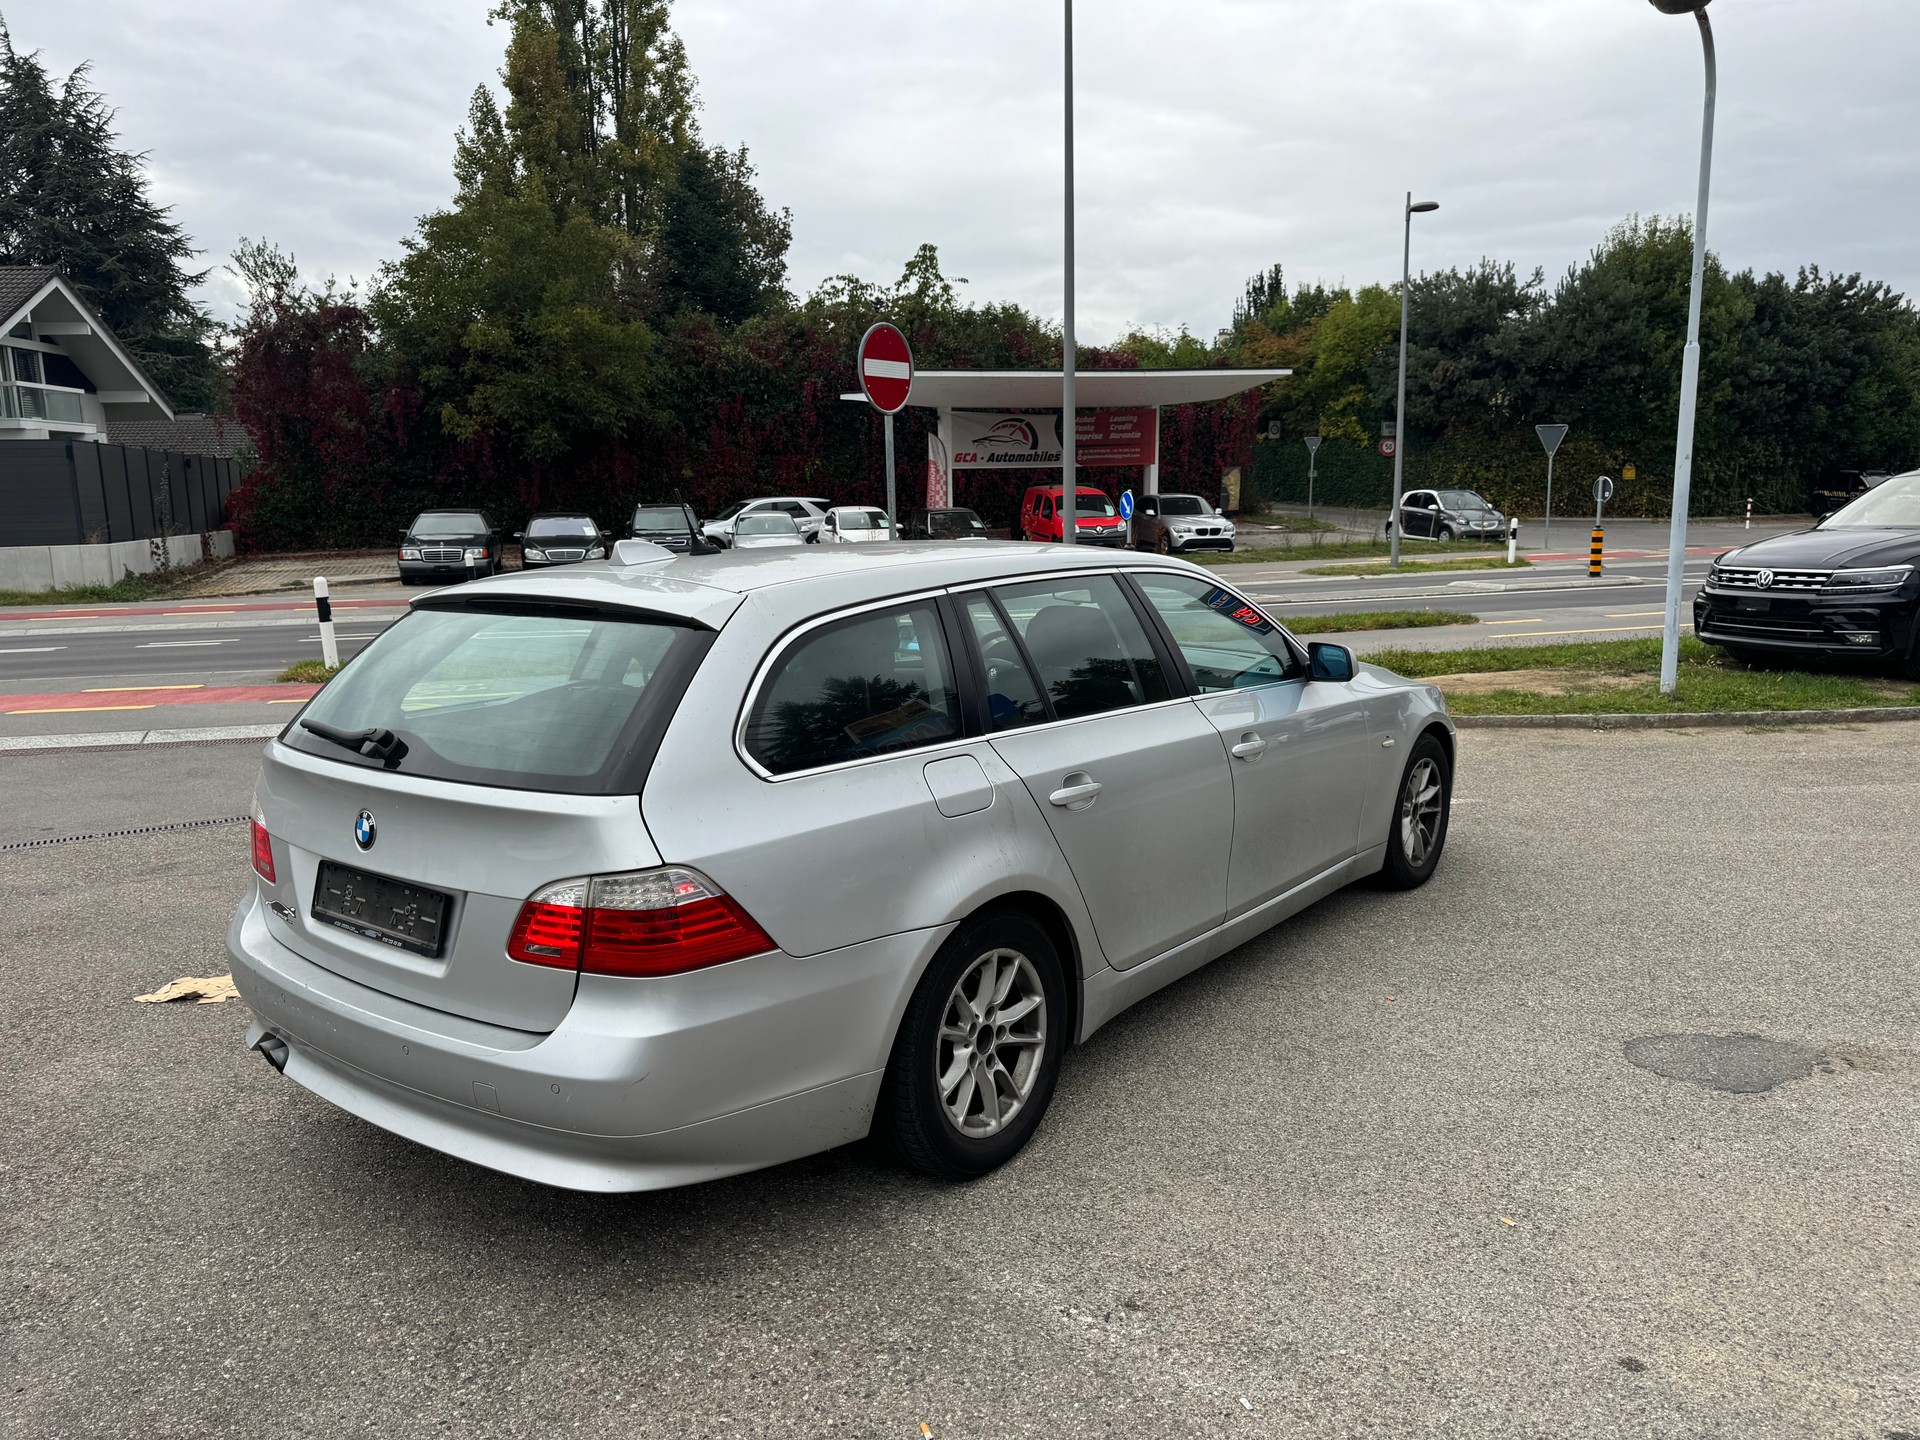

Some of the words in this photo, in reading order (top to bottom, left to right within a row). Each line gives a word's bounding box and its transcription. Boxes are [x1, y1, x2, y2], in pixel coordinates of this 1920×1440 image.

[1384, 443, 1393, 451] 50
[954, 452, 977, 463] GCA
[986, 451, 1061, 463] Automobiles
